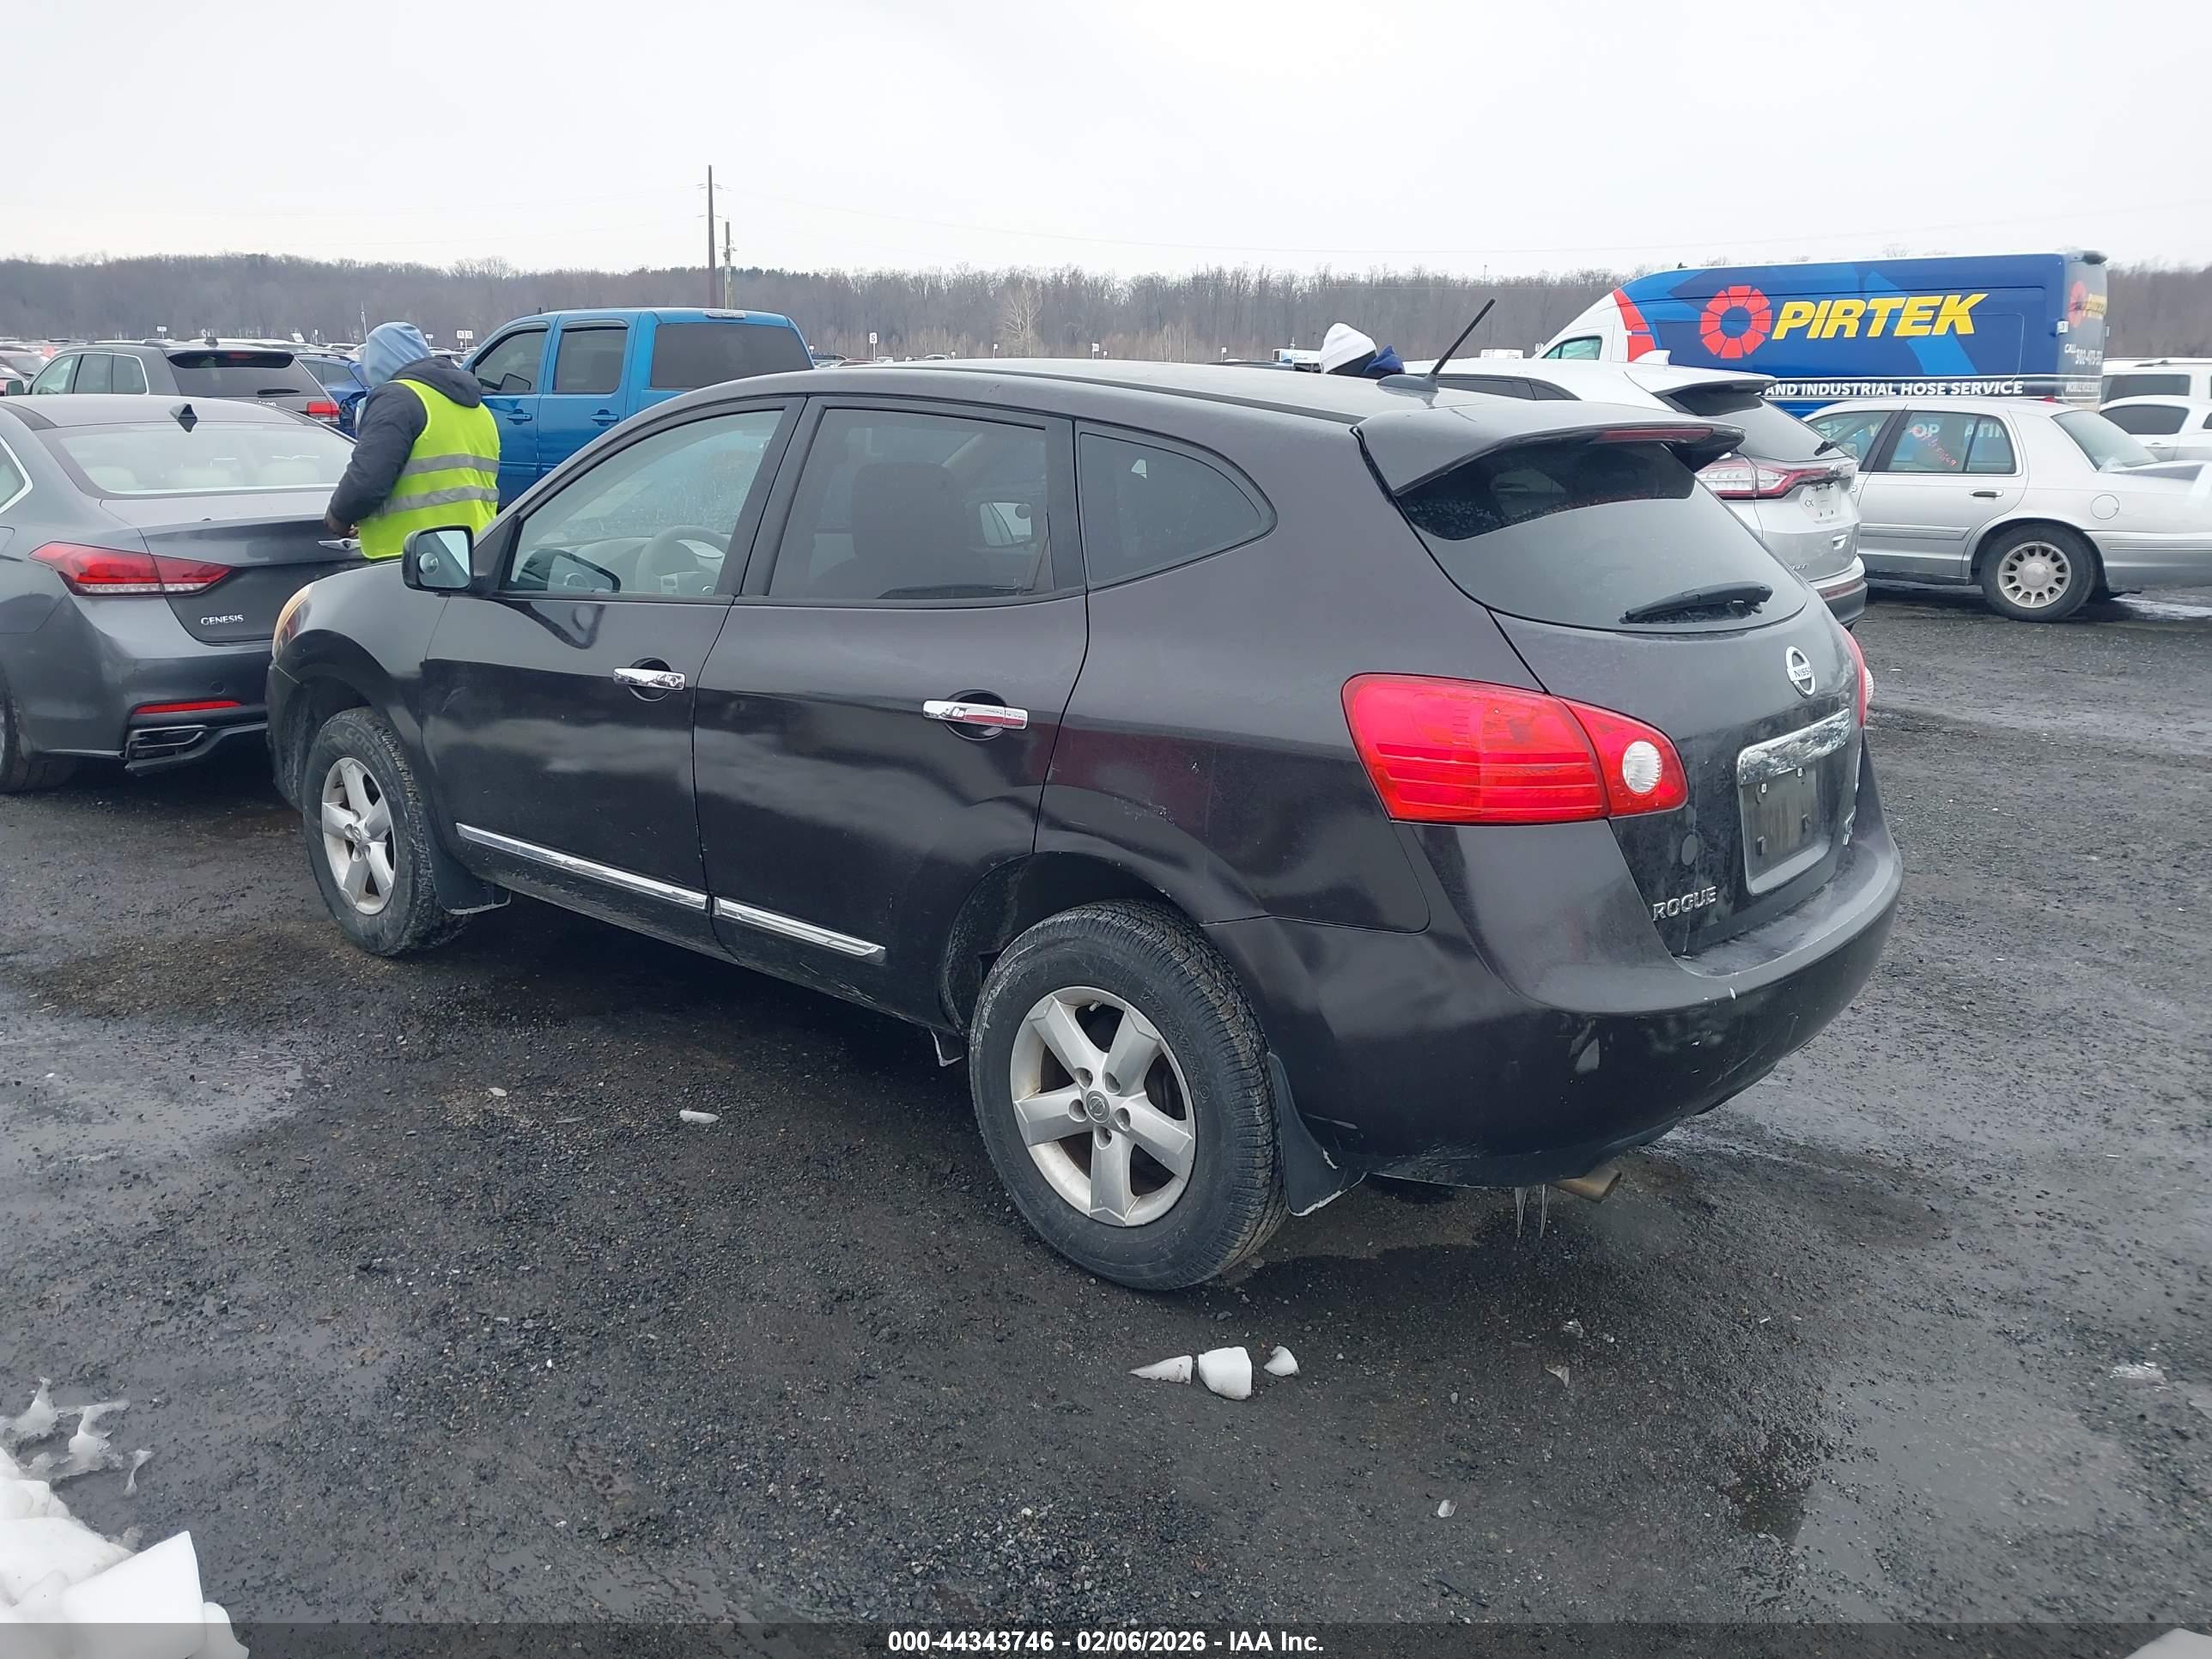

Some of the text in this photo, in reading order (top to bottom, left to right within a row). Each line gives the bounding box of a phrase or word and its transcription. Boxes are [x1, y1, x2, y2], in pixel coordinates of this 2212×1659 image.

[1771, 293, 1989, 340] PIRTEK
[1765, 380, 2024, 395] AND INDUSTRIAL HOSE SERVICE
[200, 615, 244, 625] GENESIS
[1653, 886, 1717, 921] ROGUE
